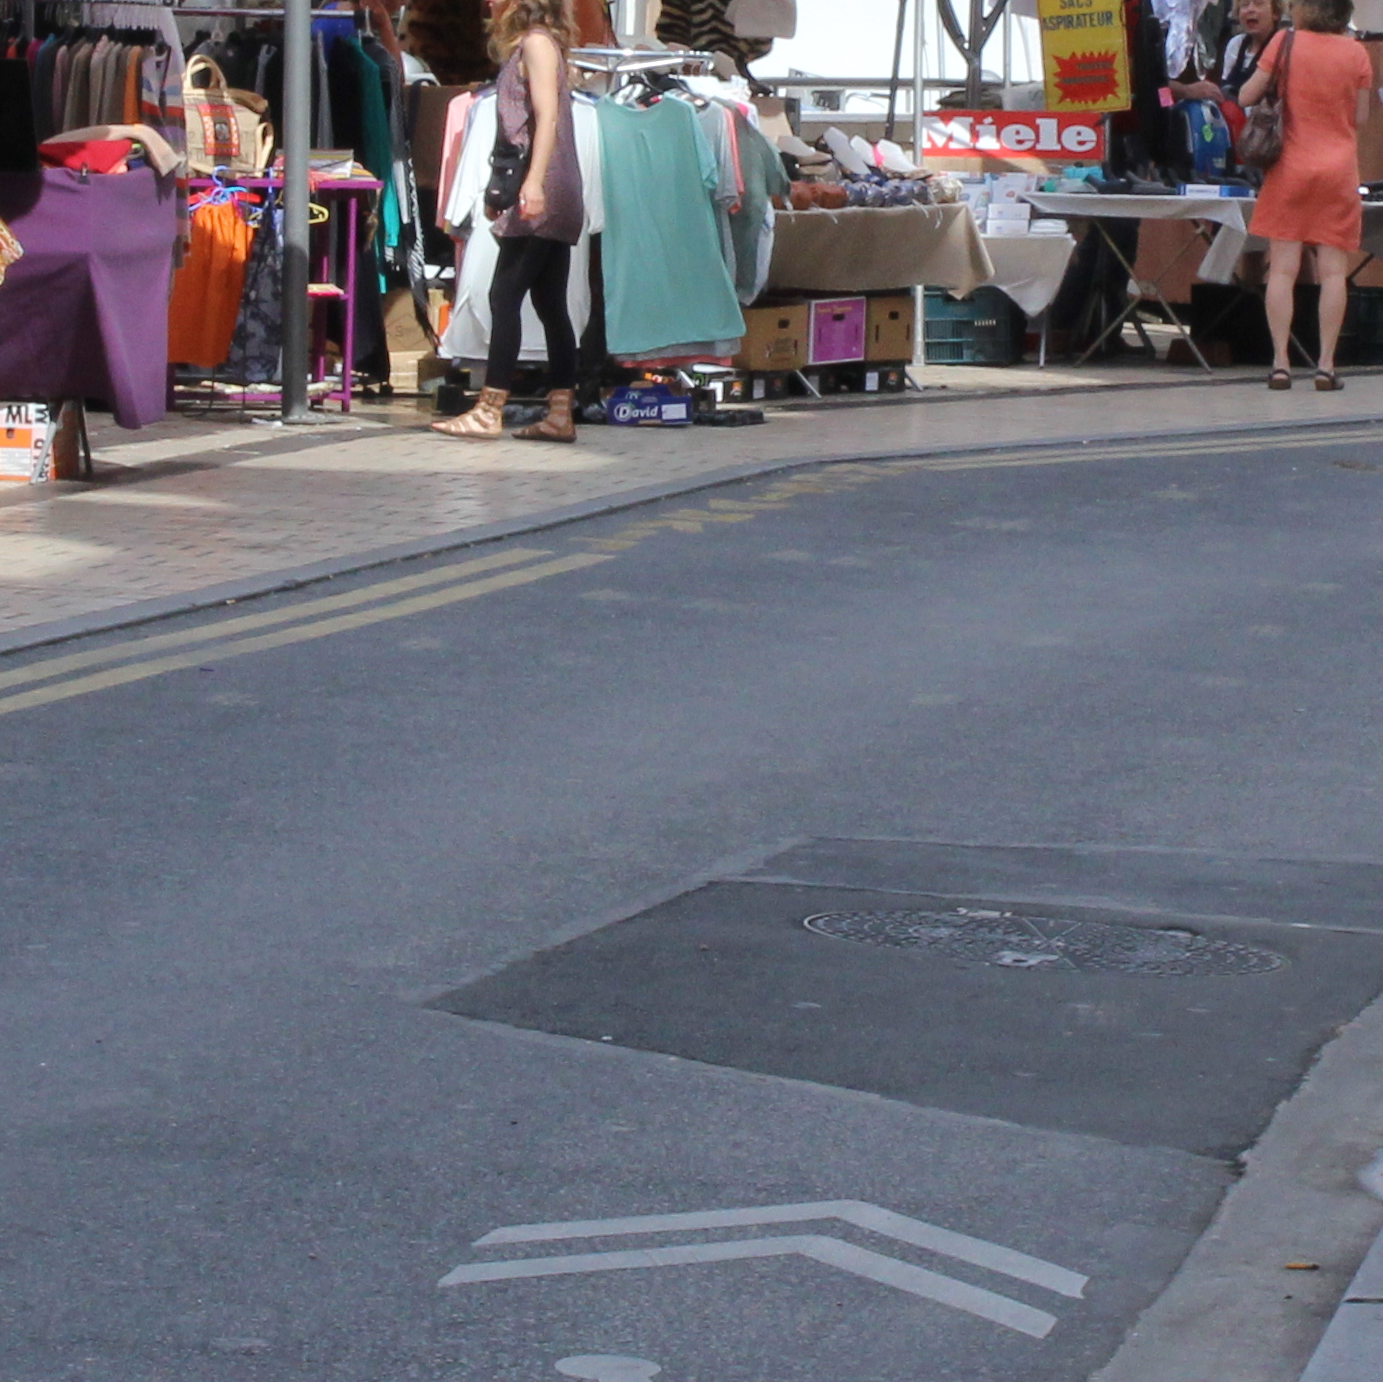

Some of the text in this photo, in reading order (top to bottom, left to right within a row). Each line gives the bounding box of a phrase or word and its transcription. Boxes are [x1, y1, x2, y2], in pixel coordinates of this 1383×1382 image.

[1043, 11, 1114, 31] ASPIRATEUR
[922, 116, 1098, 153] Miele
[616, 404, 659, 420] David
